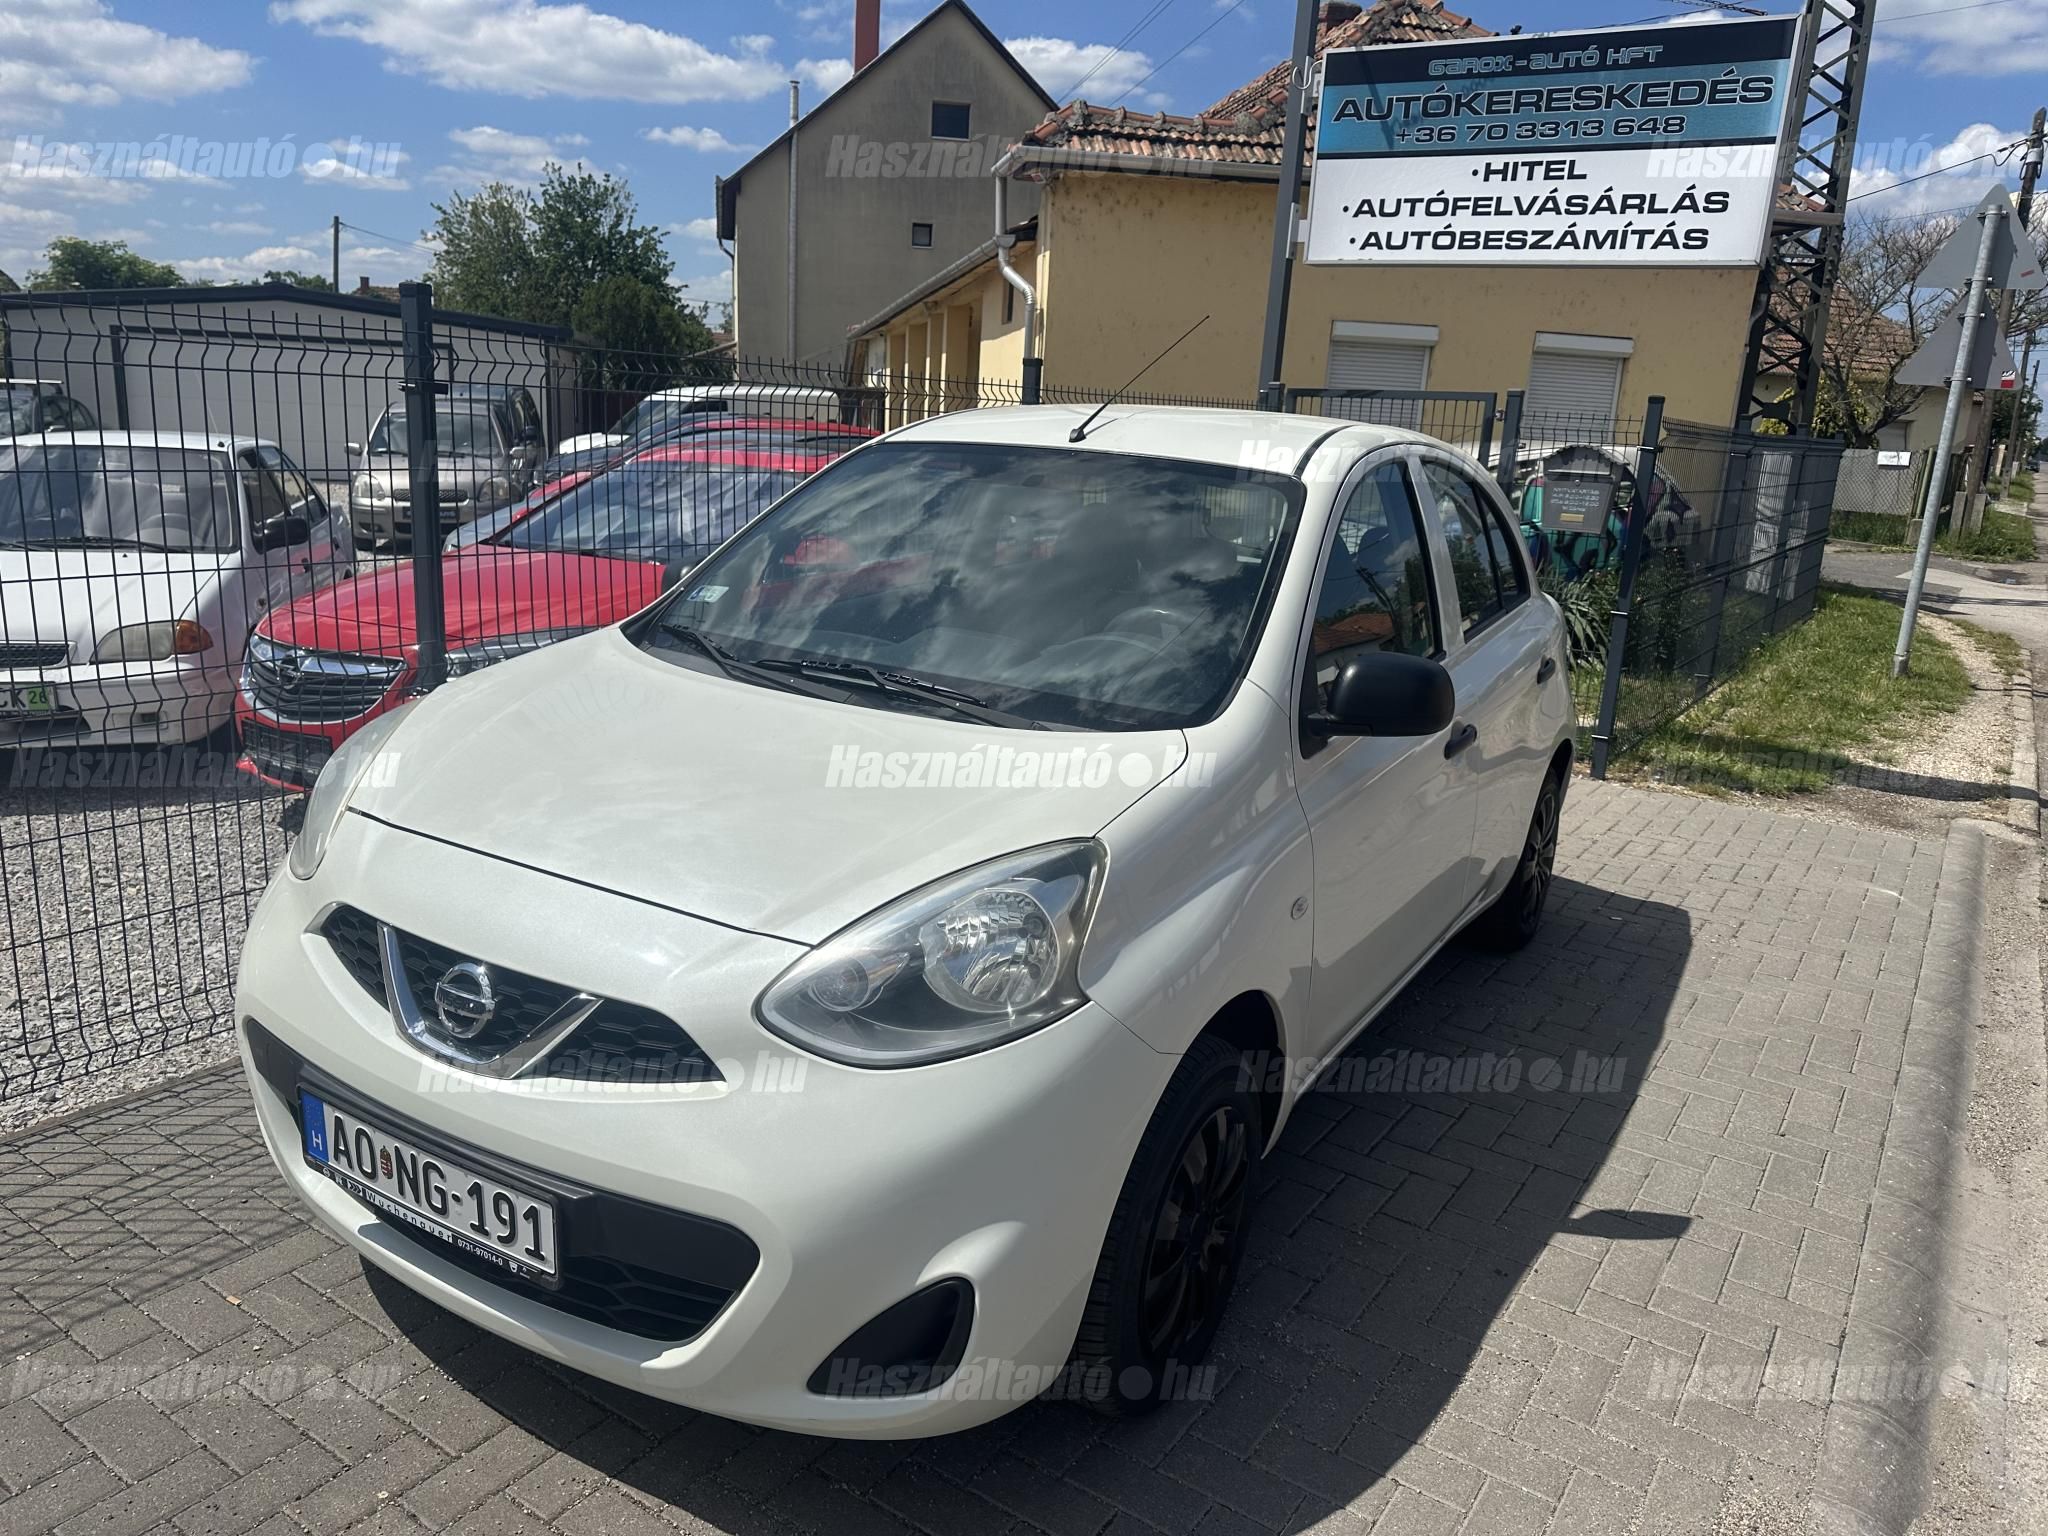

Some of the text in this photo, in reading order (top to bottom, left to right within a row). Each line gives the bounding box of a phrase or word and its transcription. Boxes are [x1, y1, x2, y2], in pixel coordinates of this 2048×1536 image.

[1606, 45, 1663, 65] HFT
[1332, 67, 1775, 123] AUTÓKERESKEDÉS
[1395, 116, 1687, 144] +36 70 3313 648
[1482, 160, 1588, 183] HITEL
[1352, 184, 1730, 219] AUTÓFELVÁSÁRLÁS
[1359, 222, 1710, 252] AUTÓBESZÁMÍTÁS
[312, 1130, 323, 1151] H
